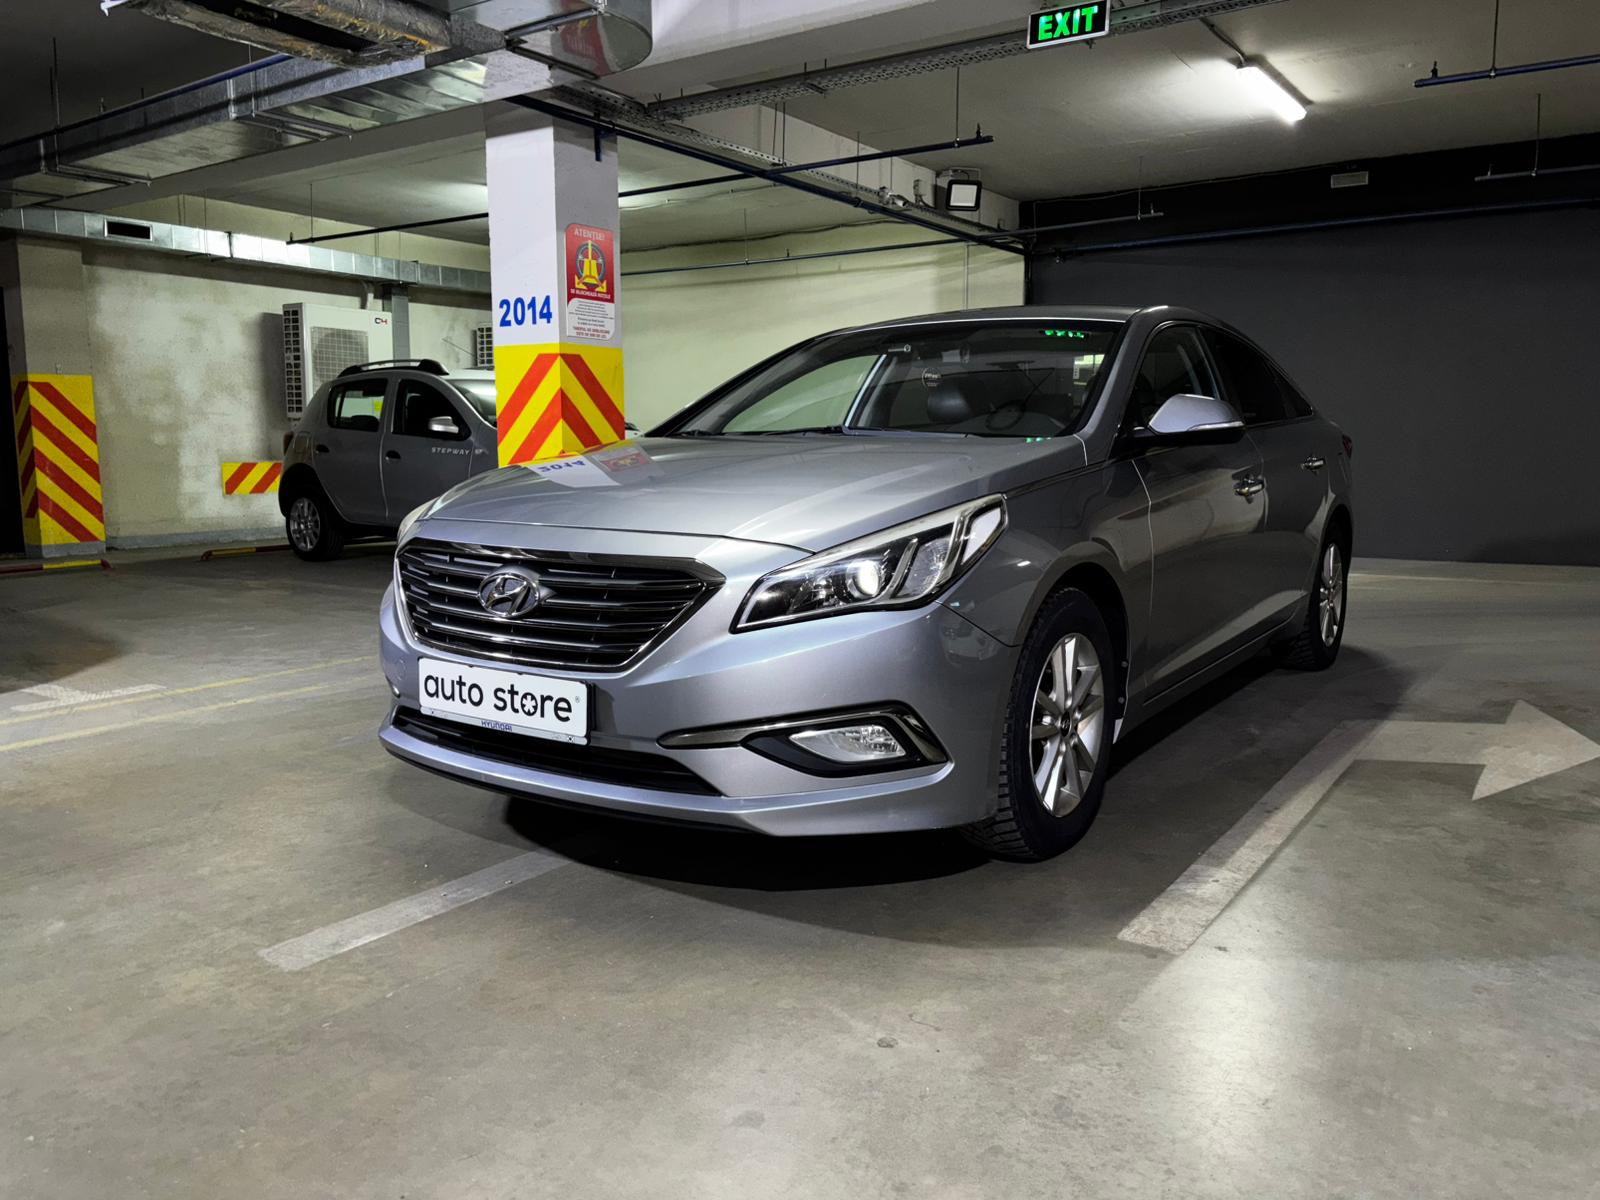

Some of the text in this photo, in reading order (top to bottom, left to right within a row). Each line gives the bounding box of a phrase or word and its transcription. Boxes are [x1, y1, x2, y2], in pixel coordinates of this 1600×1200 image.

[1038, 5, 1099, 41] EXIT
[499, 295, 553, 327] 2014
[431, 447, 470, 455] STEPWAY
[424, 674, 573, 722] auto store
[481, 720, 513, 732] HYUNDAI
